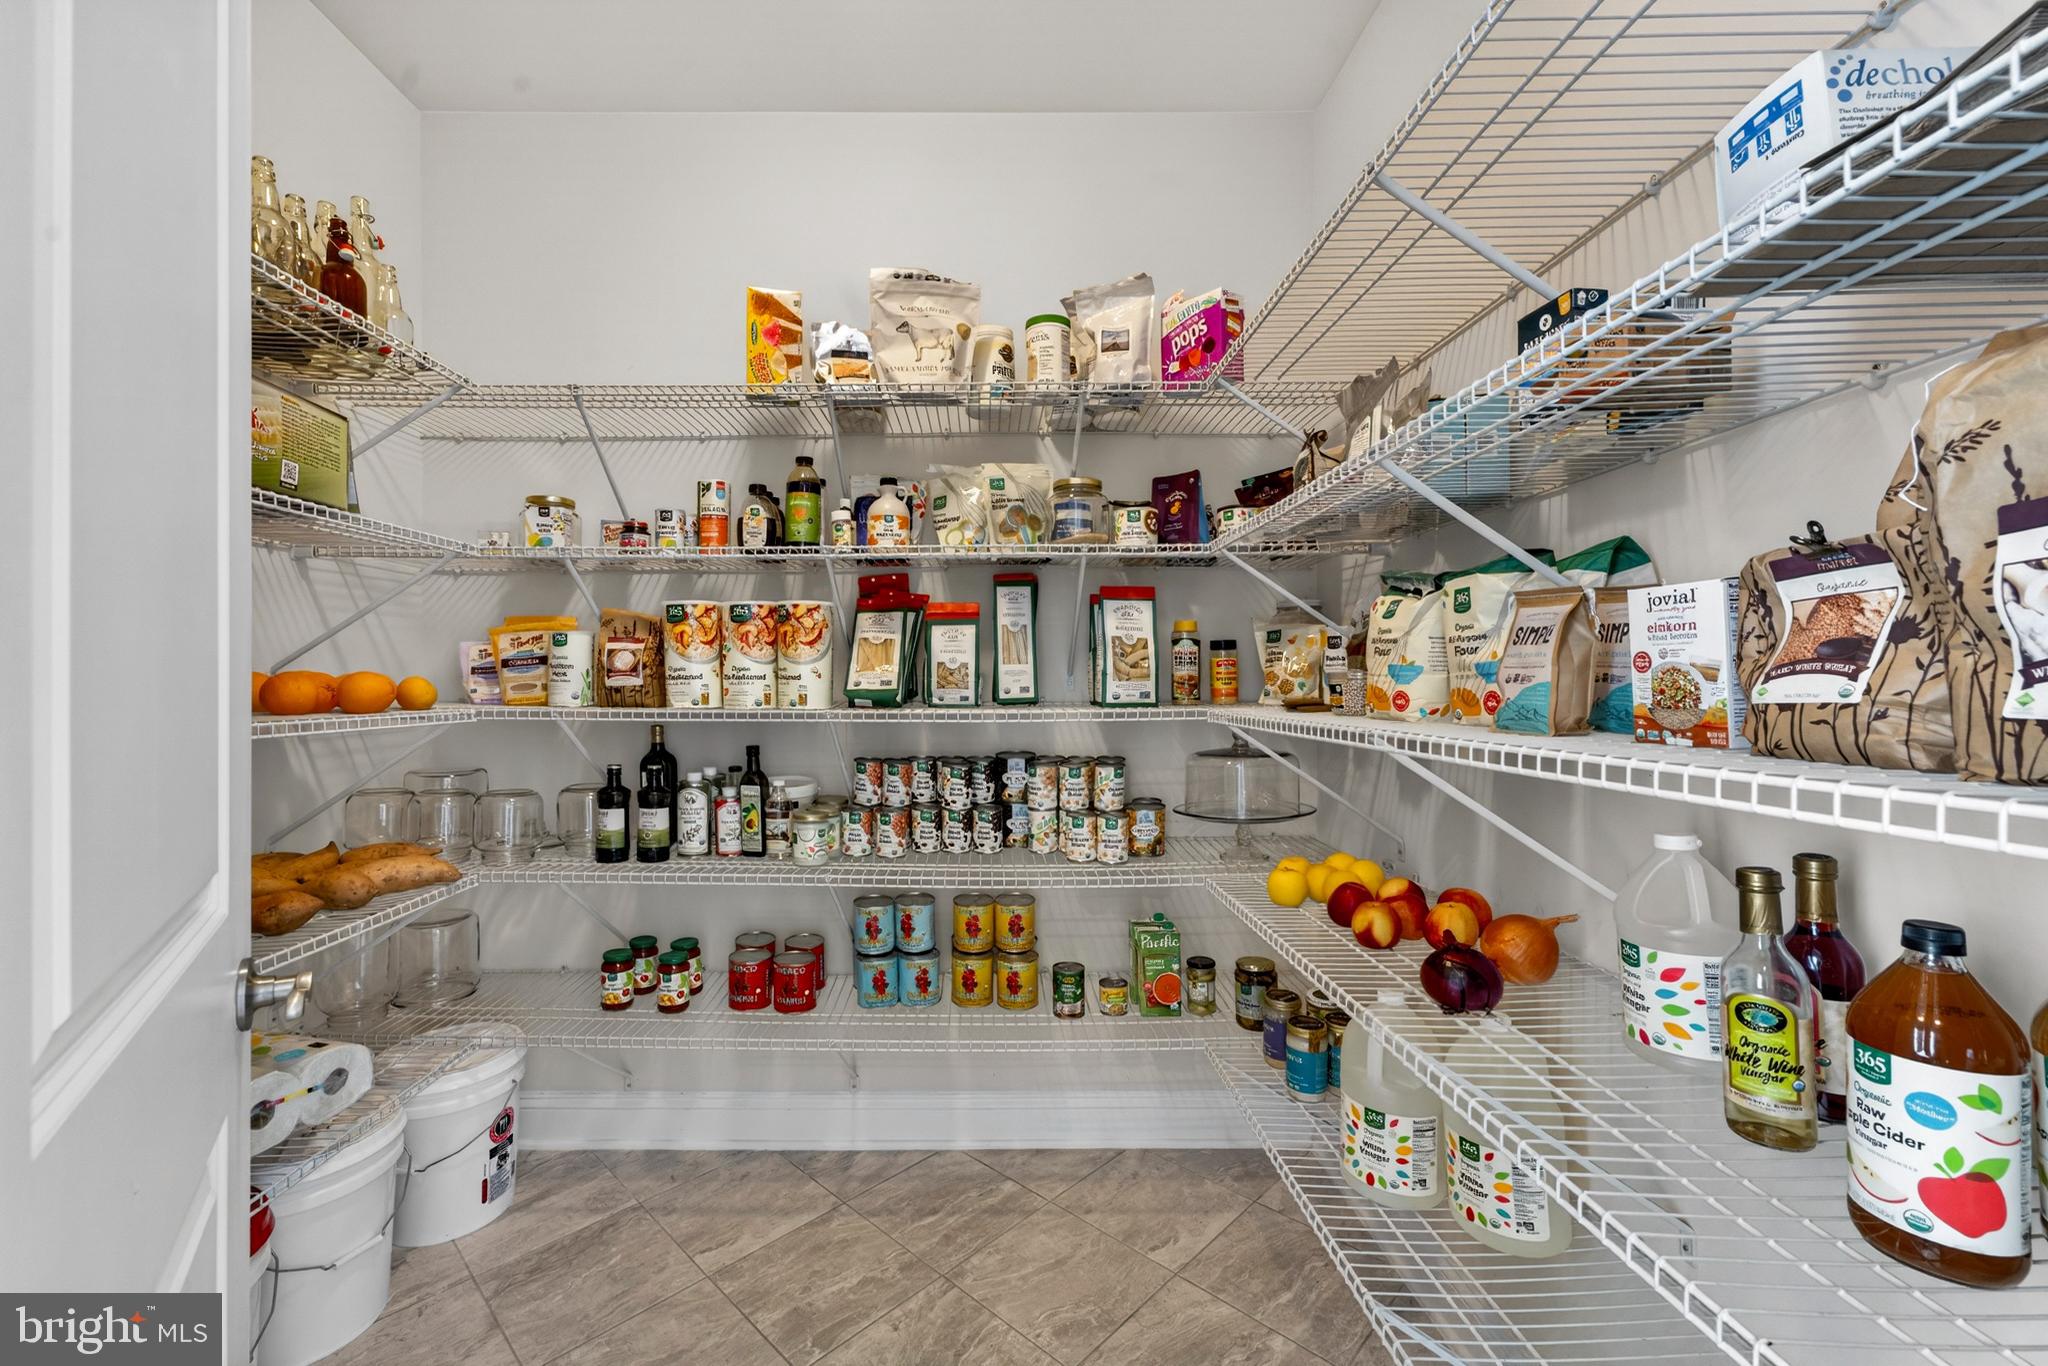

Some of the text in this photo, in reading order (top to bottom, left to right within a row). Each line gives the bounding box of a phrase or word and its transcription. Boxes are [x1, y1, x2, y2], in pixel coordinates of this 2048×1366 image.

[1171, 318, 1208, 360] pops
[1646, 588, 1696, 613] jovial
[1598, 622, 1630, 643] SIMP
[1647, 621, 1697, 633] einkorn
[1140, 934, 1179, 949] Pacific
[1739, 1035, 1791, 1057] Organic
[1725, 1044, 1806, 1077] White Wine
[1855, 1047, 1887, 1074] 365
[1740, 1066, 1788, 1085] Vinegar
[1853, 1080, 1892, 1107] Organic
[1856, 1096, 1886, 1121] Raw
[1848, 1108, 1926, 1151] ple Cider
[1855, 1128, 1888, 1150] Vinegar
